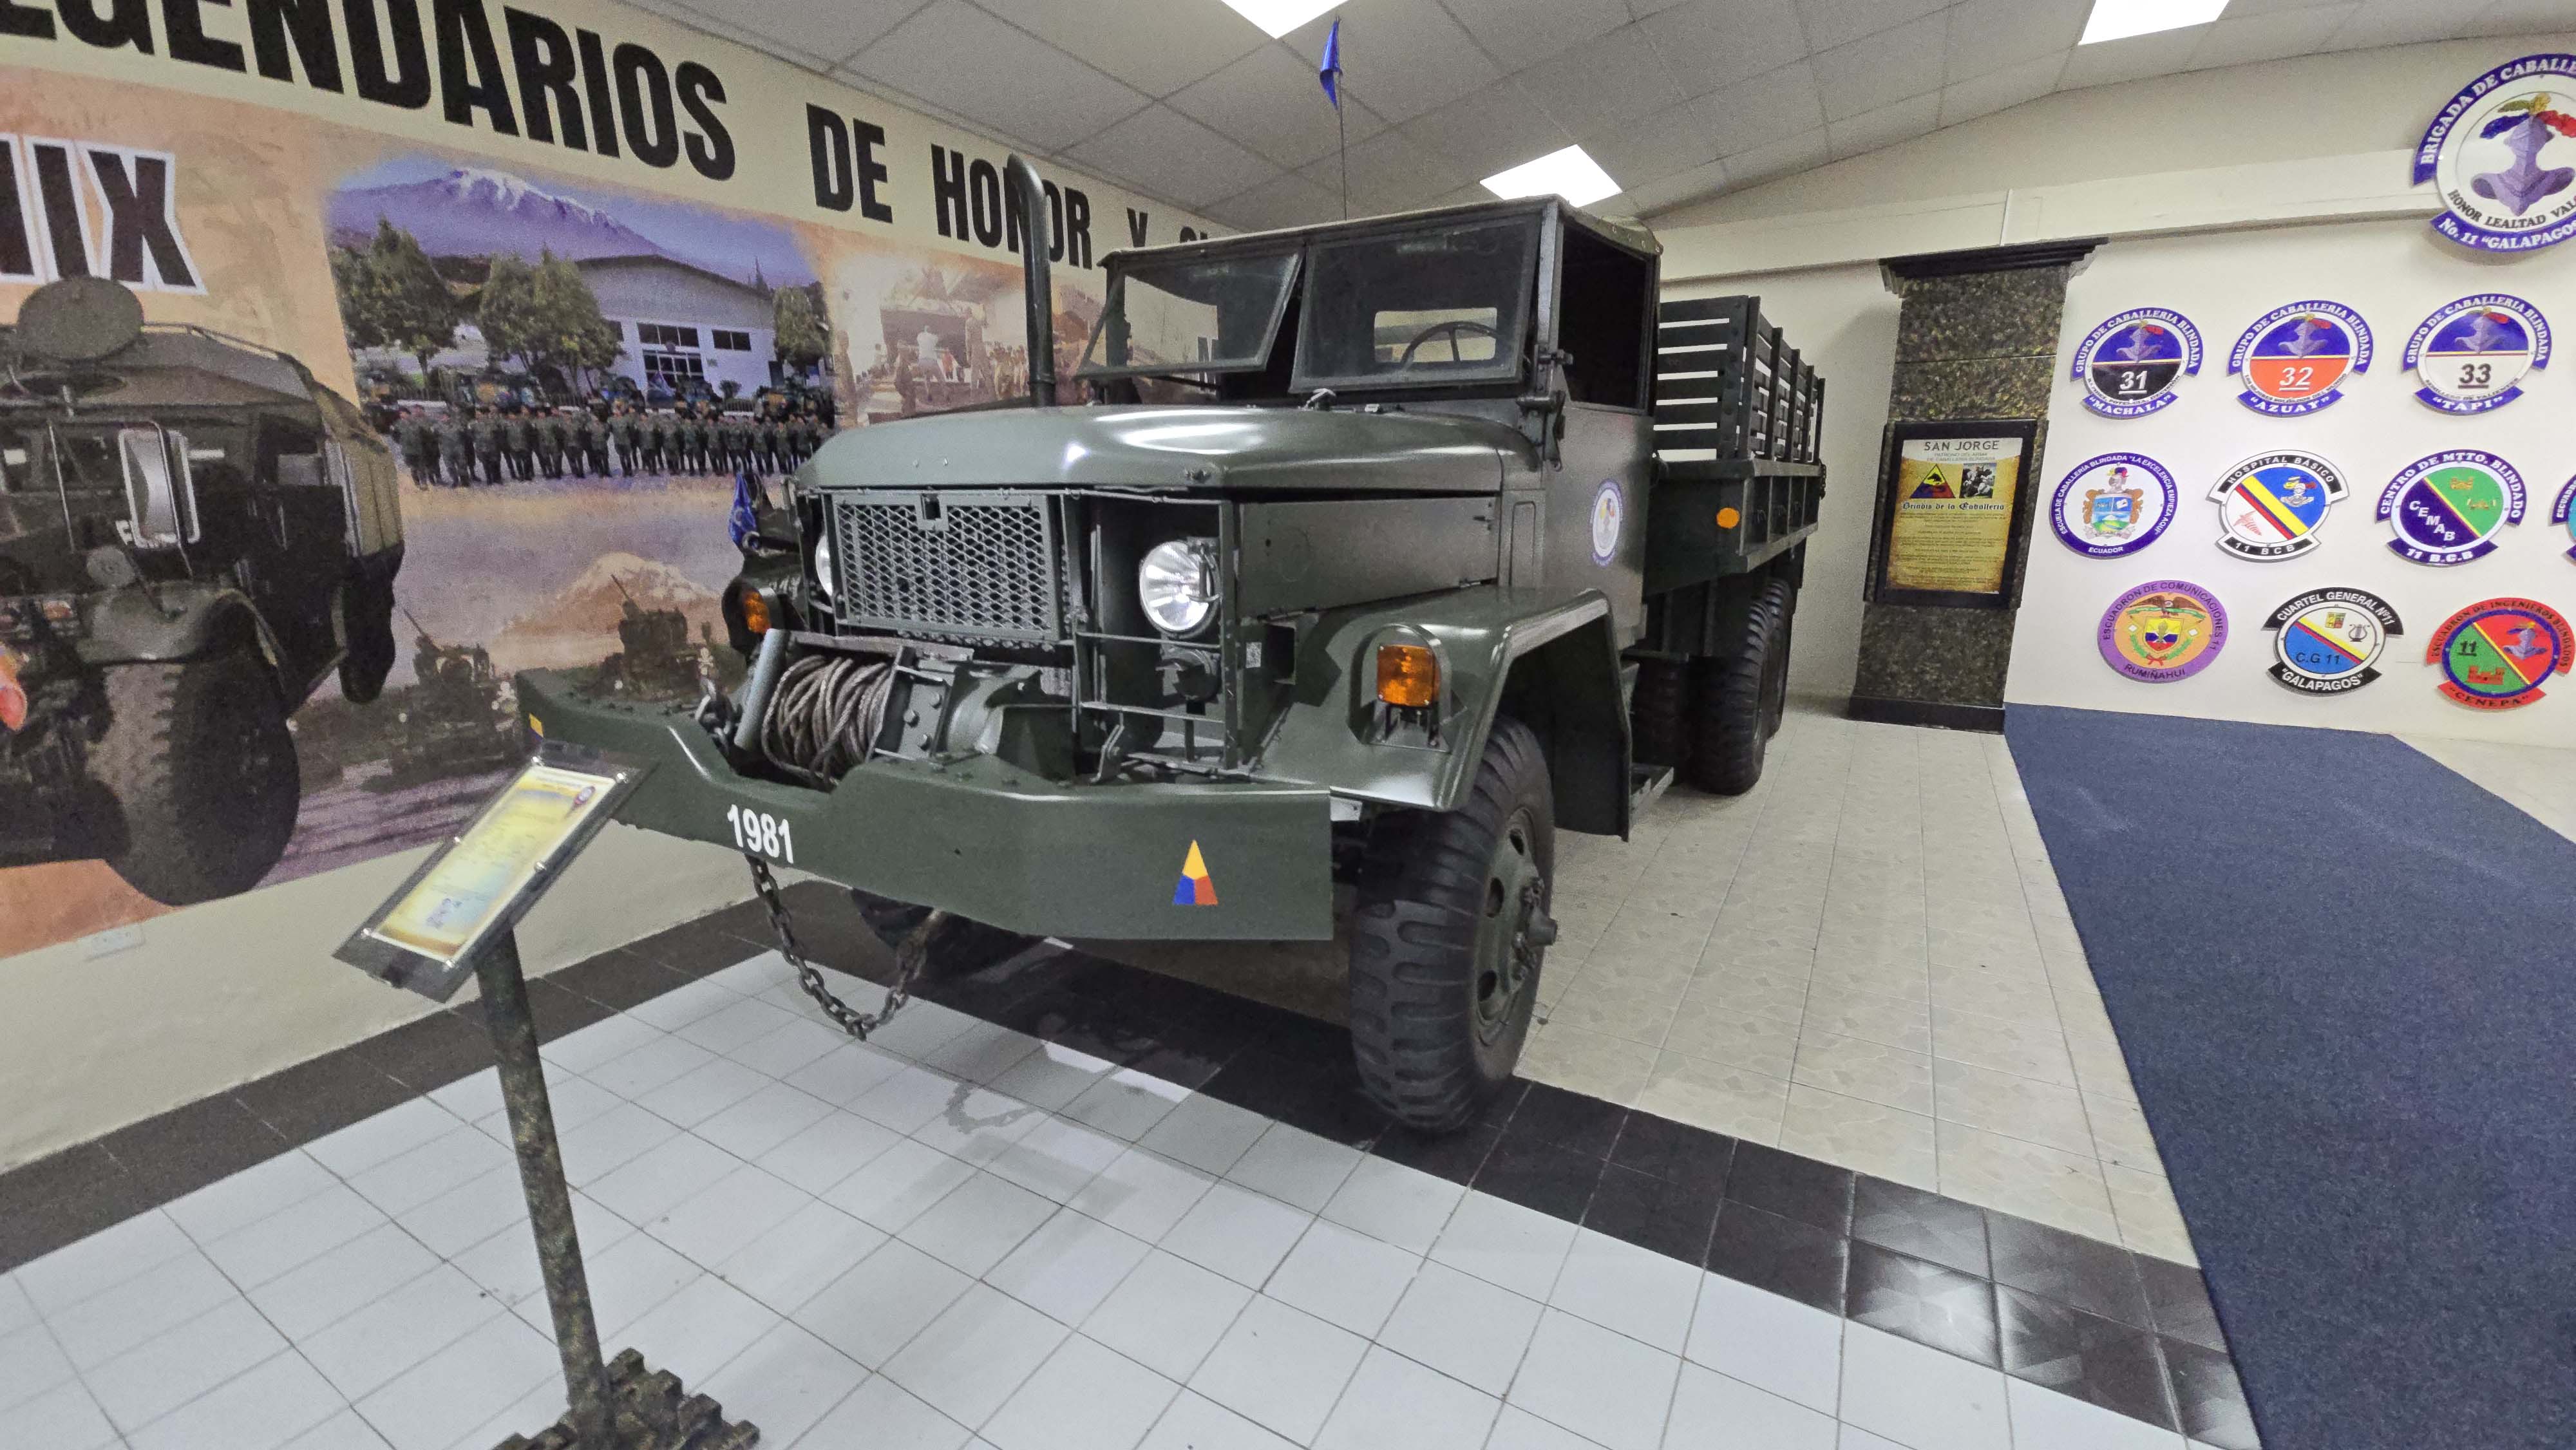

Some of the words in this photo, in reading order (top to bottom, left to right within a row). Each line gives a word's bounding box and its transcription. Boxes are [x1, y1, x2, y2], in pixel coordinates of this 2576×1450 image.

[0, 0, 736, 181] NDARIOS
[806, 102, 893, 224] DE
[2421, 95, 2474, 165] BRIGADA
[2470, 74, 2499, 96] DE
[2447, 189, 2483, 221] HONOR
[2485, 214, 2546, 229] LEALTAD
[2461, 232, 2478, 245] 11
[2076, 339, 2094, 373] GRUPO
[2092, 326, 2107, 339] DE
[2108, 310, 2177, 327] CABALLERIA
[2177, 317, 2200, 368] BLINDADA
[2231, 332, 2255, 367] GRUPO
[2255, 319, 2271, 333] DE
[2270, 303, 2347, 320] CABALLERIA
[2346, 314, 2371, 365] BLINDADA
[2407, 328, 2429, 363] GRUPO
[2430, 312, 2445, 328] DE
[2444, 296, 2526, 315] CABALLERIA
[2524, 308, 2549, 362] BLINDADA
[2119, 371, 2148, 390] 31
[2279, 367, 2314, 386] 32
[2459, 363, 2492, 384] 33
[1924, 441, 1950, 451] SAN
[1955, 440, 2000, 451] JORGE
[2228, 457, 2287, 484] HOSPITAL
[2054, 506, 2069, 535] ESCUELA
[2089, 455, 2127, 467] BLINDADA
[2142, 459, 2173, 490] EXCELENCIA
[2167, 489, 2175, 516] EMPIEZA
[2380, 469, 2416, 514] CENTRO
[2418, 457, 2439, 470] DE
[2490, 459, 2524, 518] BLINDADO
[2409, 500, 2456, 541] CEMAB
[2235, 543, 2250, 552] 11
[2407, 549, 2423, 559] 11
[2103, 589, 2142, 640] ESCUADRON
[2143, 583, 2157, 593] DE
[2160, 582, 2223, 637] COMUNICACIONES
[2210, 641, 2220, 650] 11
[2277, 594, 2324, 621] CUARTEL
[2326, 592, 2376, 610] GENERAL
[2490, 601, 2554, 619] INGENIEROS
[2325, 654, 2340, 664] 11
[2460, 641, 2477, 653] 11
[2125, 664, 2185, 679] RUMIÑAHUI
[727, 804, 793, 864] 1981
